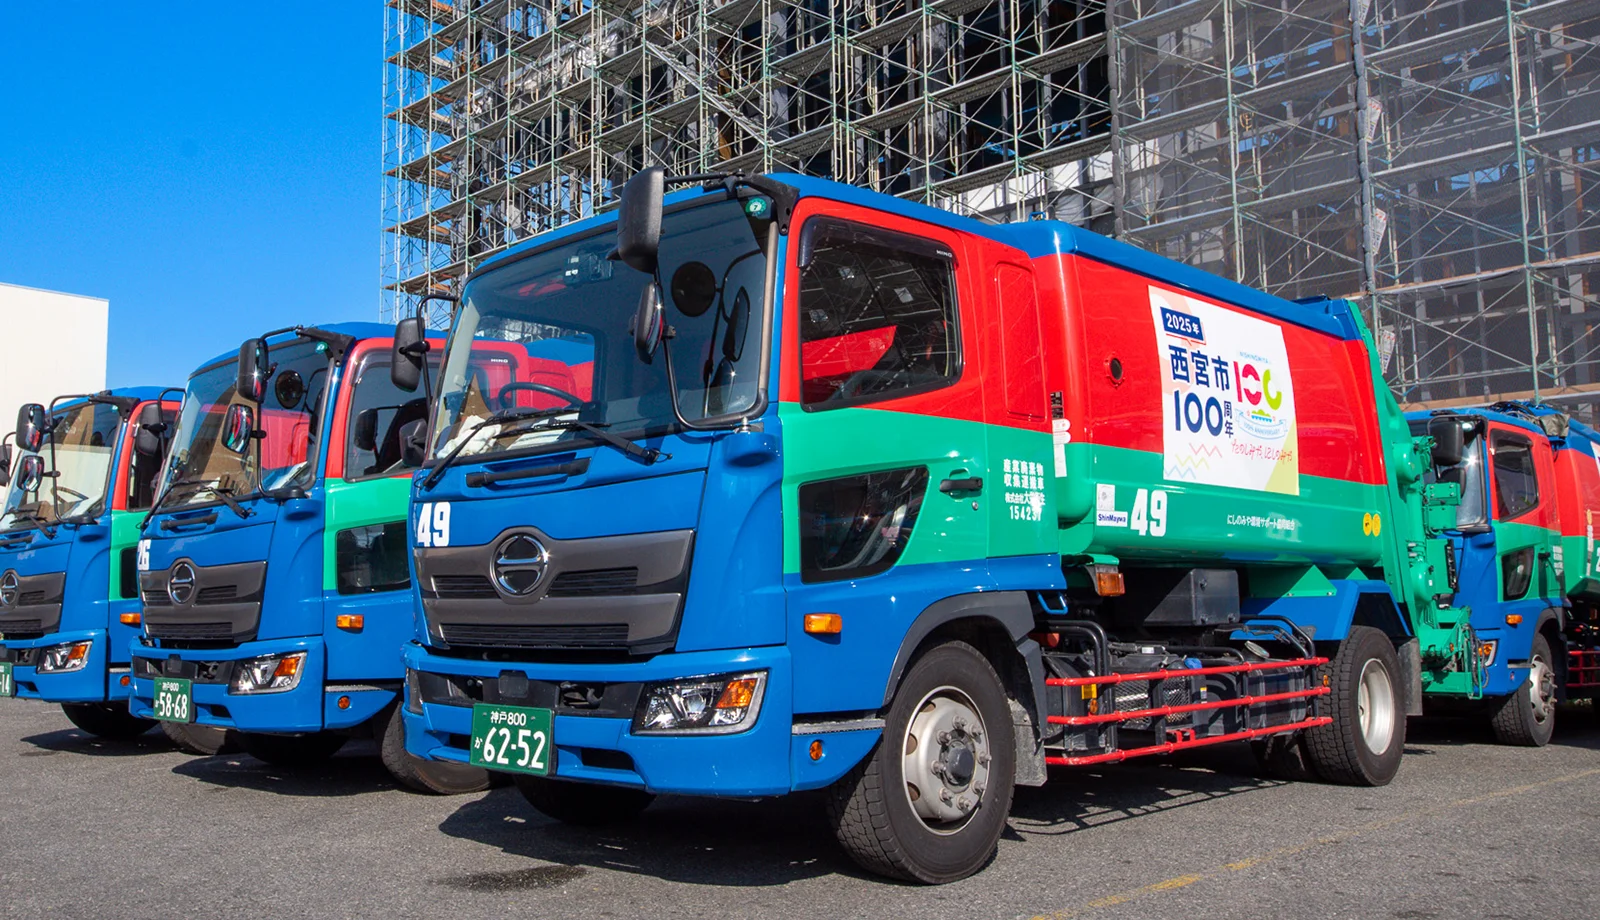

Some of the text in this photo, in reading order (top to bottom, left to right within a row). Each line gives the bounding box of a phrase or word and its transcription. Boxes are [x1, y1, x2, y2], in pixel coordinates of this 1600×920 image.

[936, 249, 953, 258] HINO
[1165, 312, 1200, 335] 2025年
[1168, 344, 1230, 391] 西宮市
[417, 501, 451, 547] 49
[1098, 513, 1126, 523] ShinMaywa
[1130, 488, 1167, 537] 49
[490, 710, 527, 727] 神戸800
[483, 726, 546, 770] 62-52
